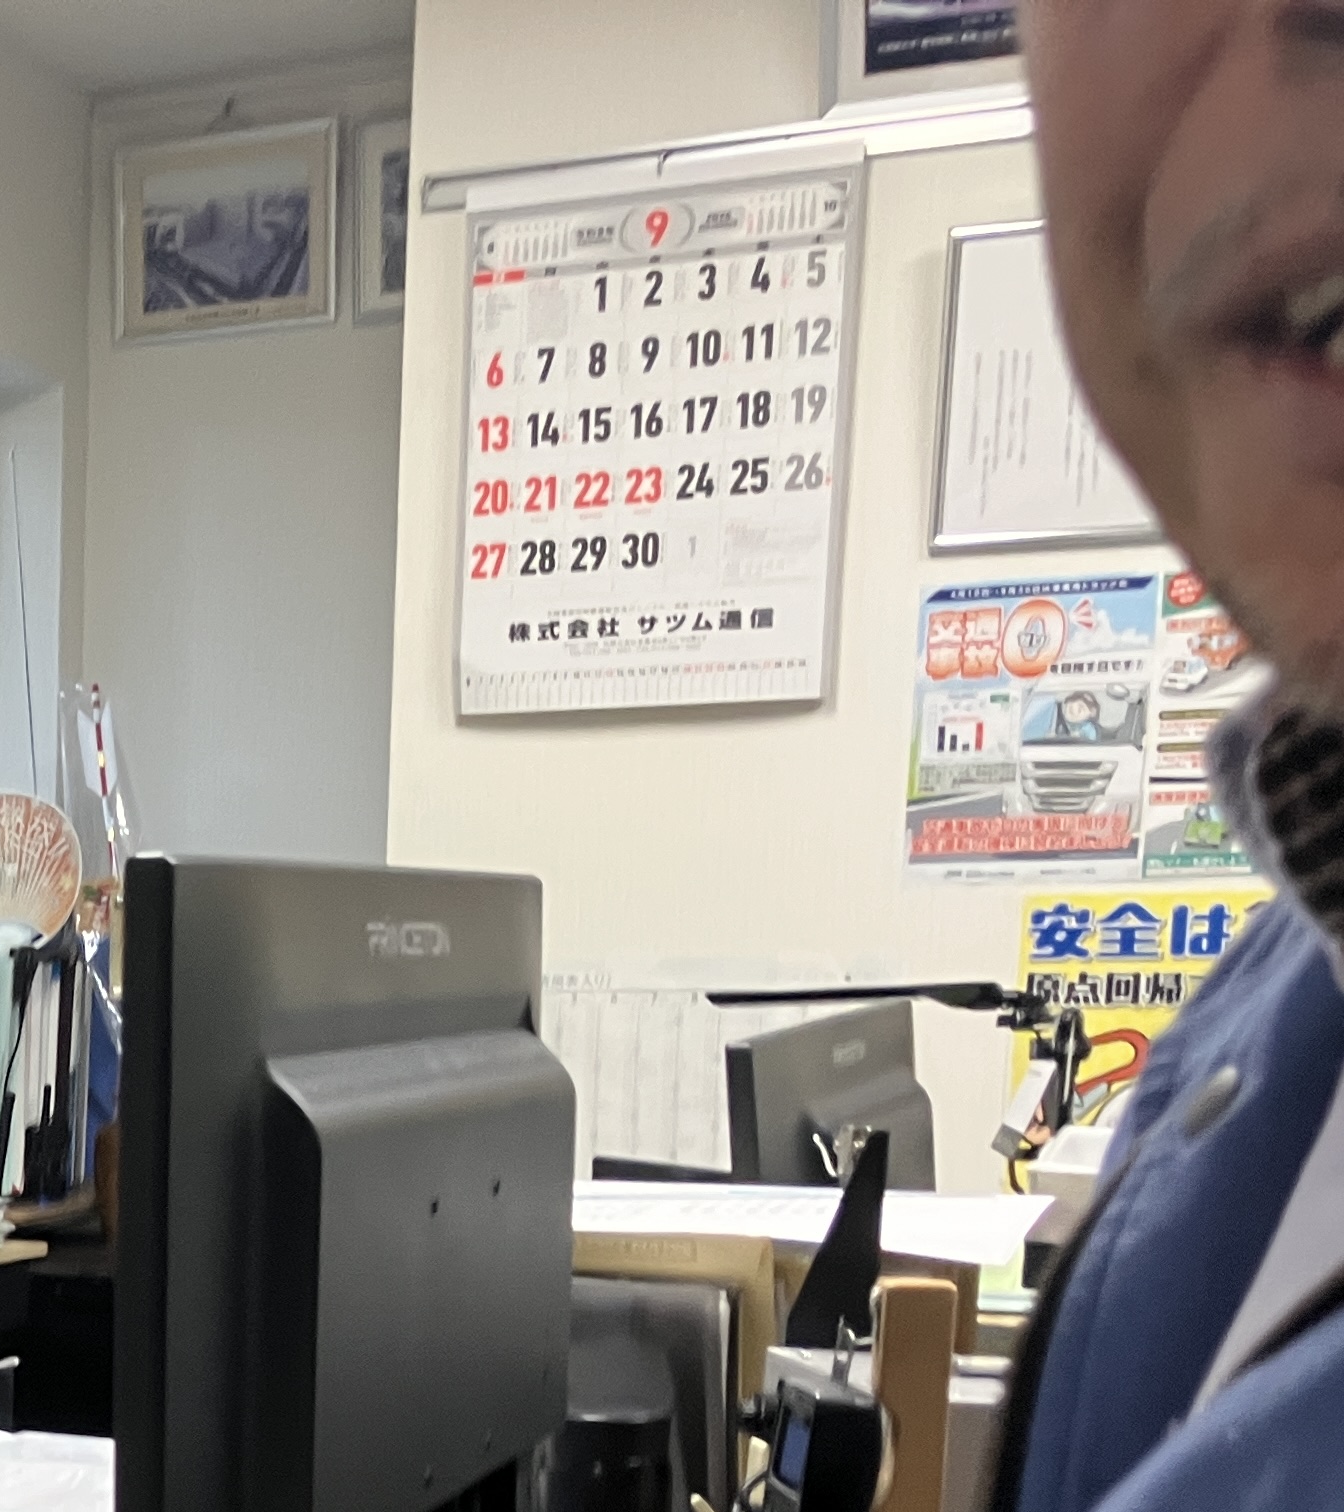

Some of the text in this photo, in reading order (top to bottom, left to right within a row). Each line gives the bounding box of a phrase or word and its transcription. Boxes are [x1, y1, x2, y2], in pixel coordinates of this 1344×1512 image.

[645, 209, 670, 249] 9
[596, 277, 606, 311] 1
[645, 271, 662, 306] 2
[699, 264, 715, 299] 3
[752, 257, 769, 292] 4
[809, 251, 825, 285] 5
[488, 319, 830, 387] 6 7 8 9 10 11 12
[480, 387, 825, 451] 13 14 15 16 17 18 19
[474, 454, 822, 515] 20 21 22 23 24 25 26
[472, 544, 505, 578] 27
[521, 541, 555, 575] 28
[572, 537, 606, 571] 29
[623, 533, 658, 568] 30
[508, 617, 620, 643] 株式会社
[1030, 902, 1232, 958] 安全は
[1026, 971, 1204, 1006] 原点回帰
